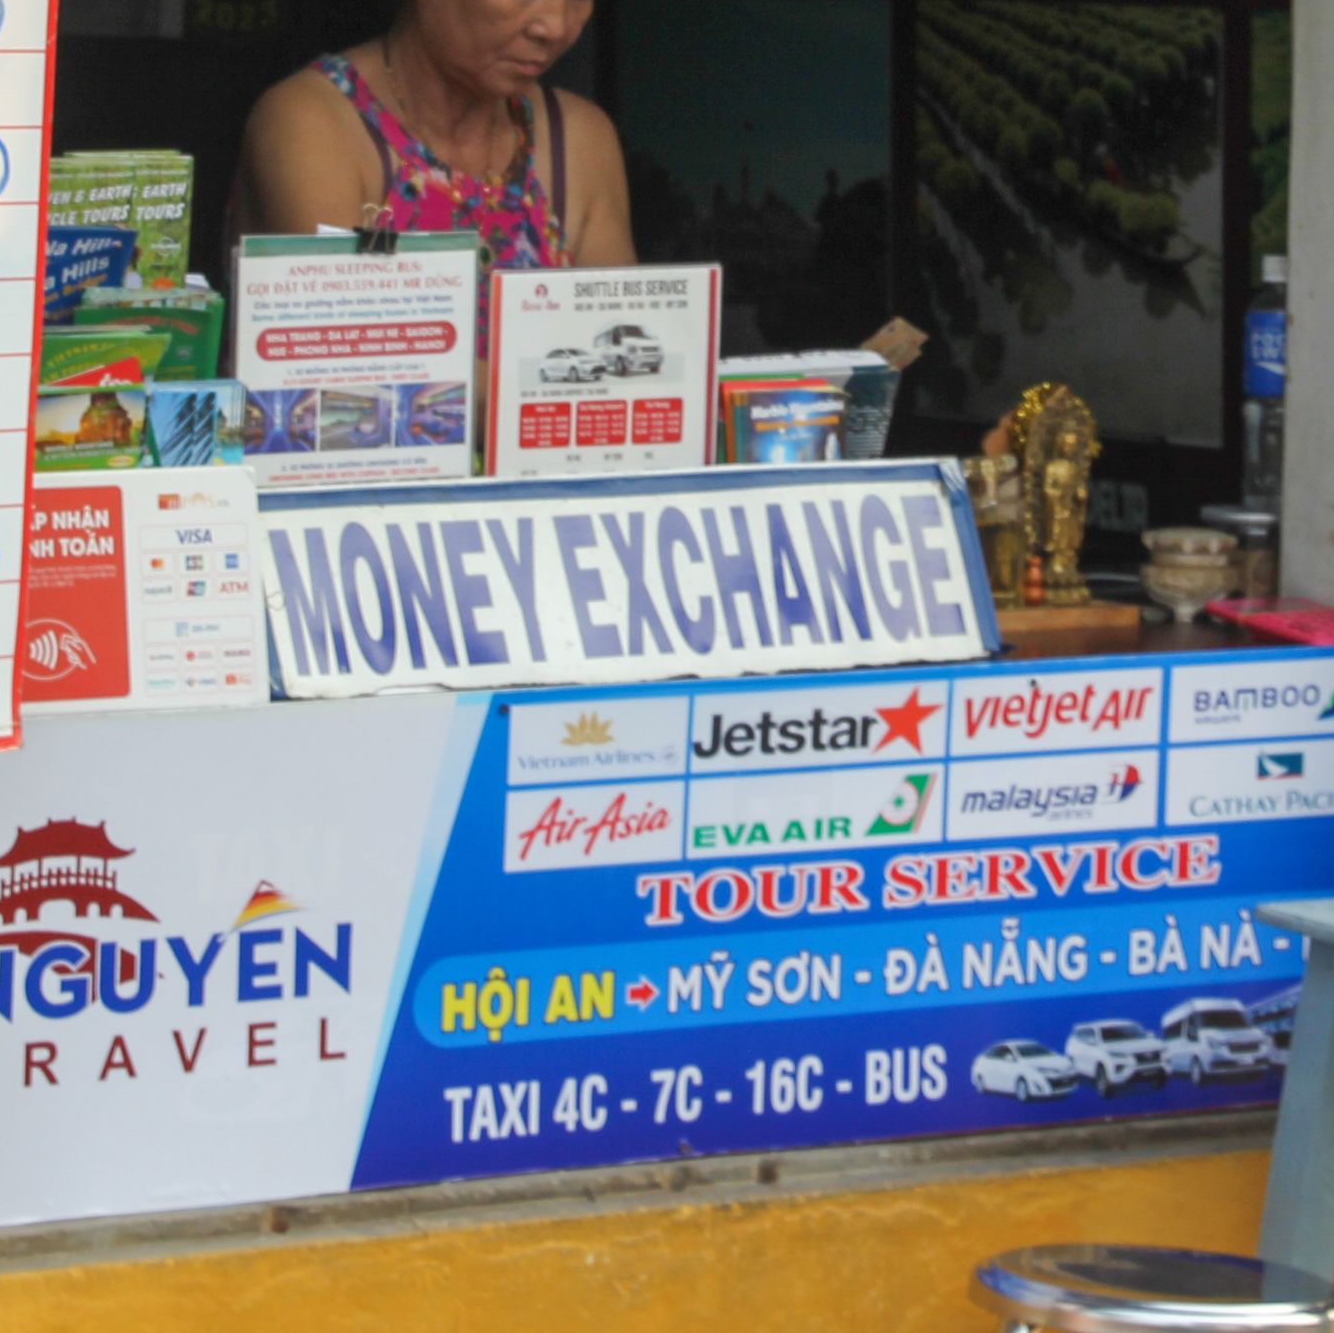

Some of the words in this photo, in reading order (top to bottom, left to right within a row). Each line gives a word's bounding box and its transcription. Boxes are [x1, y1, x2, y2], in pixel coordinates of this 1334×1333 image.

[175, 528, 214, 545] VISA
[267, 516, 547, 678] MONEY
[555, 493, 967, 661] EXCHANGE
[517, 752, 591, 772] Vietnam
[593, 749, 657, 768] Airlines
[692, 708, 877, 760] Jetstar
[692, 821, 772, 849] EVA
[780, 815, 854, 843] AIR
[961, 783, 1099, 819] malaysia
[637, 861, 867, 926] TOUR
[883, 834, 1222, 908] SERVICE
[440, 966, 531, 1042] HỘI
[543, 969, 616, 1024] AN
[667, 948, 735, 1015] MỸ
[745, 948, 842, 1008] SƠN
[883, 932, 951, 996] ĐÀ
[961, 916, 1089, 989] NẴNG
[1127, 914, 1189, 976] BÀ
[1200, 908, 1263, 969] NÀ
[23, 1016, 347, 1088] RAVEL
[443, 1079, 541, 1144] TAXI
[552, 1073, 608, 1134] 4C
[650, 1064, 704, 1125] 7C
[744, 1054, 824, 1115] 16C
[864, 1043, 949, 1104] BUS
